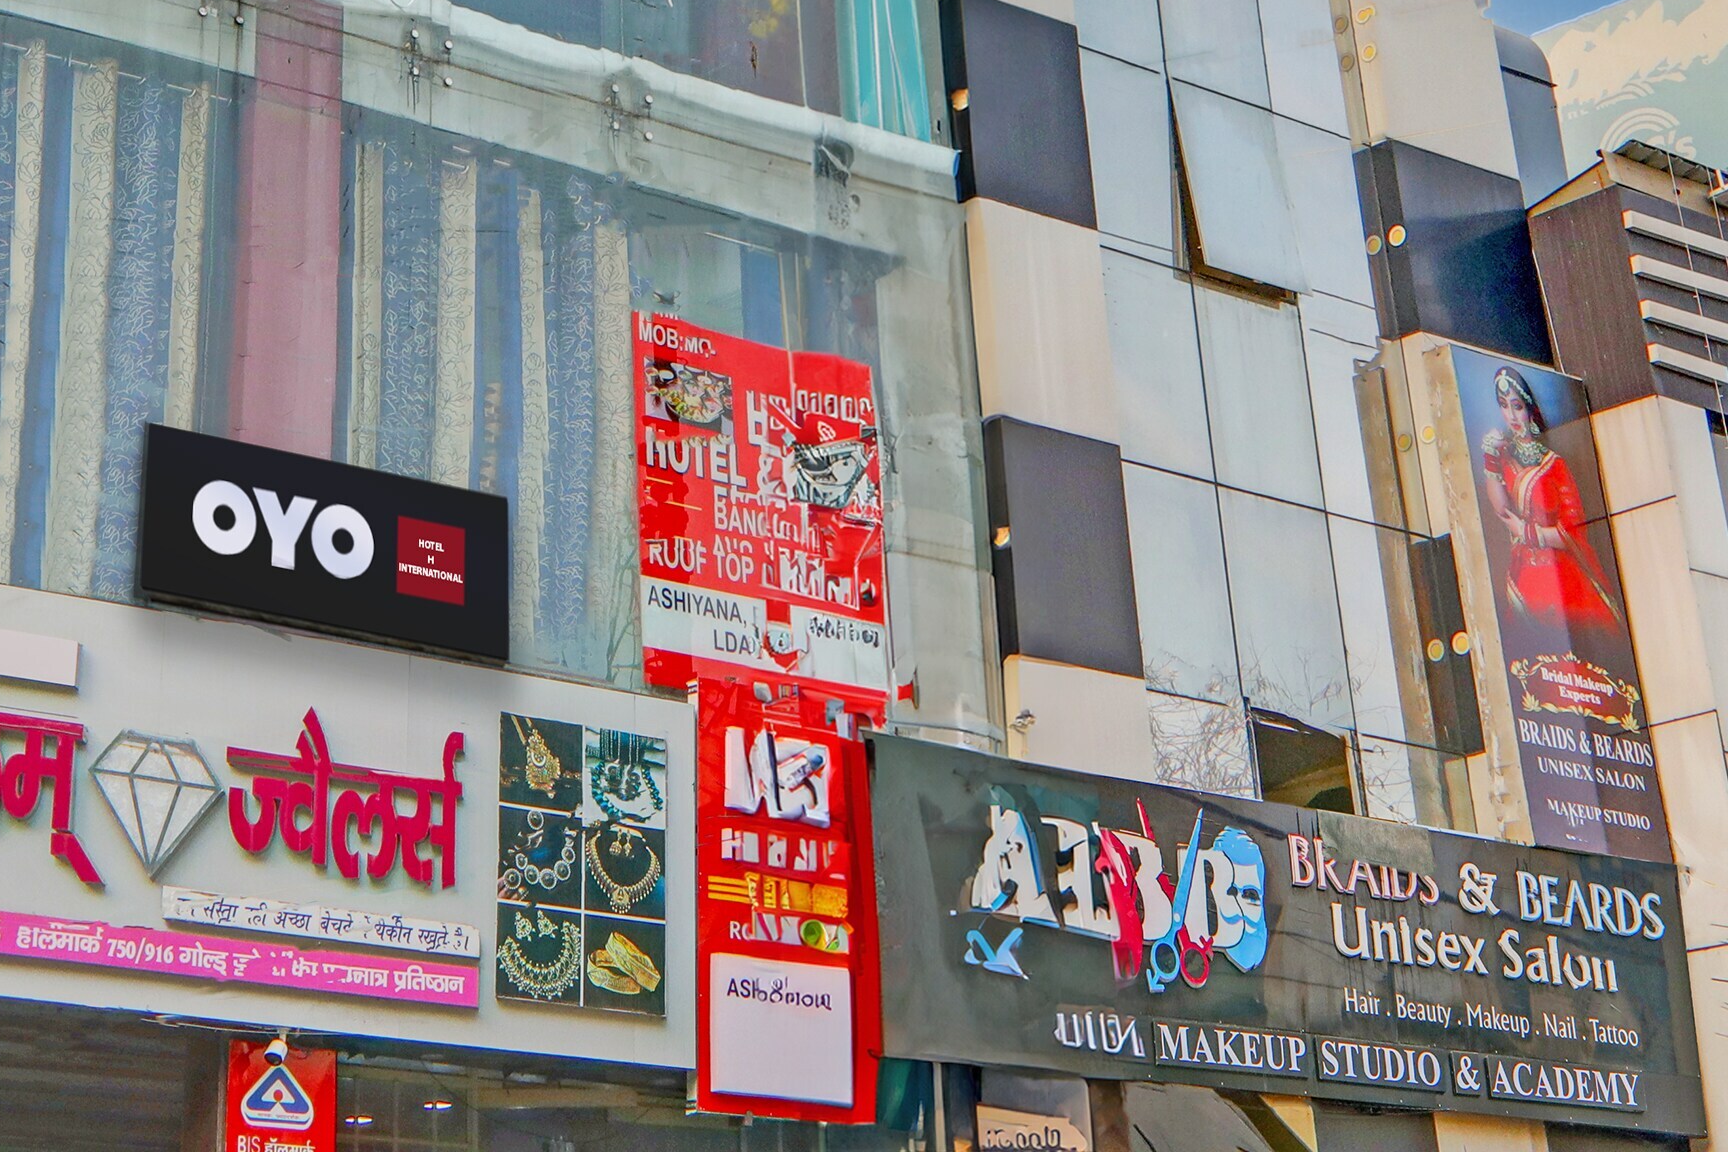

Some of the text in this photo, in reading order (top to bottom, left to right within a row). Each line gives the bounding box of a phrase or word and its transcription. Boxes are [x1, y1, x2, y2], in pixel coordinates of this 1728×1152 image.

[192, 480, 375, 580] OYO
[418, 538, 445, 553] HOTEL
[398, 562, 464, 584] INTERNATIONAL
[427, 554, 435, 565] H
[647, 584, 748, 628] ASHIYANA,
[1540, 666, 1614, 697] Bridal Makeup
[1558, 685, 1601, 705] Experts
[1518, 718, 1654, 767] BRAIDS & BEARDS
[1537, 756, 1646, 792] UNISEX SALON
[1546, 798, 1651, 831] MAKEUP STUDIO
[273, 909, 313, 932] अच्छा
[1458, 861, 1502, 916] &
[1515, 870, 1667, 942] BEARDS
[107, 937, 174, 965] 750/916
[393, 964, 466, 994] प्रतिष्ठान
[1330, 901, 1620, 993] Unisex Salon
[1343, 986, 1640, 1047] Hair Beauty Makeup Nail Tattoo
[1156, 1023, 1307, 1073] MAKEUP
[1319, 1040, 1443, 1087] STUDIO
[1455, 1054, 1481, 1091] &
[1492, 1061, 1640, 1107] ACADEMY
